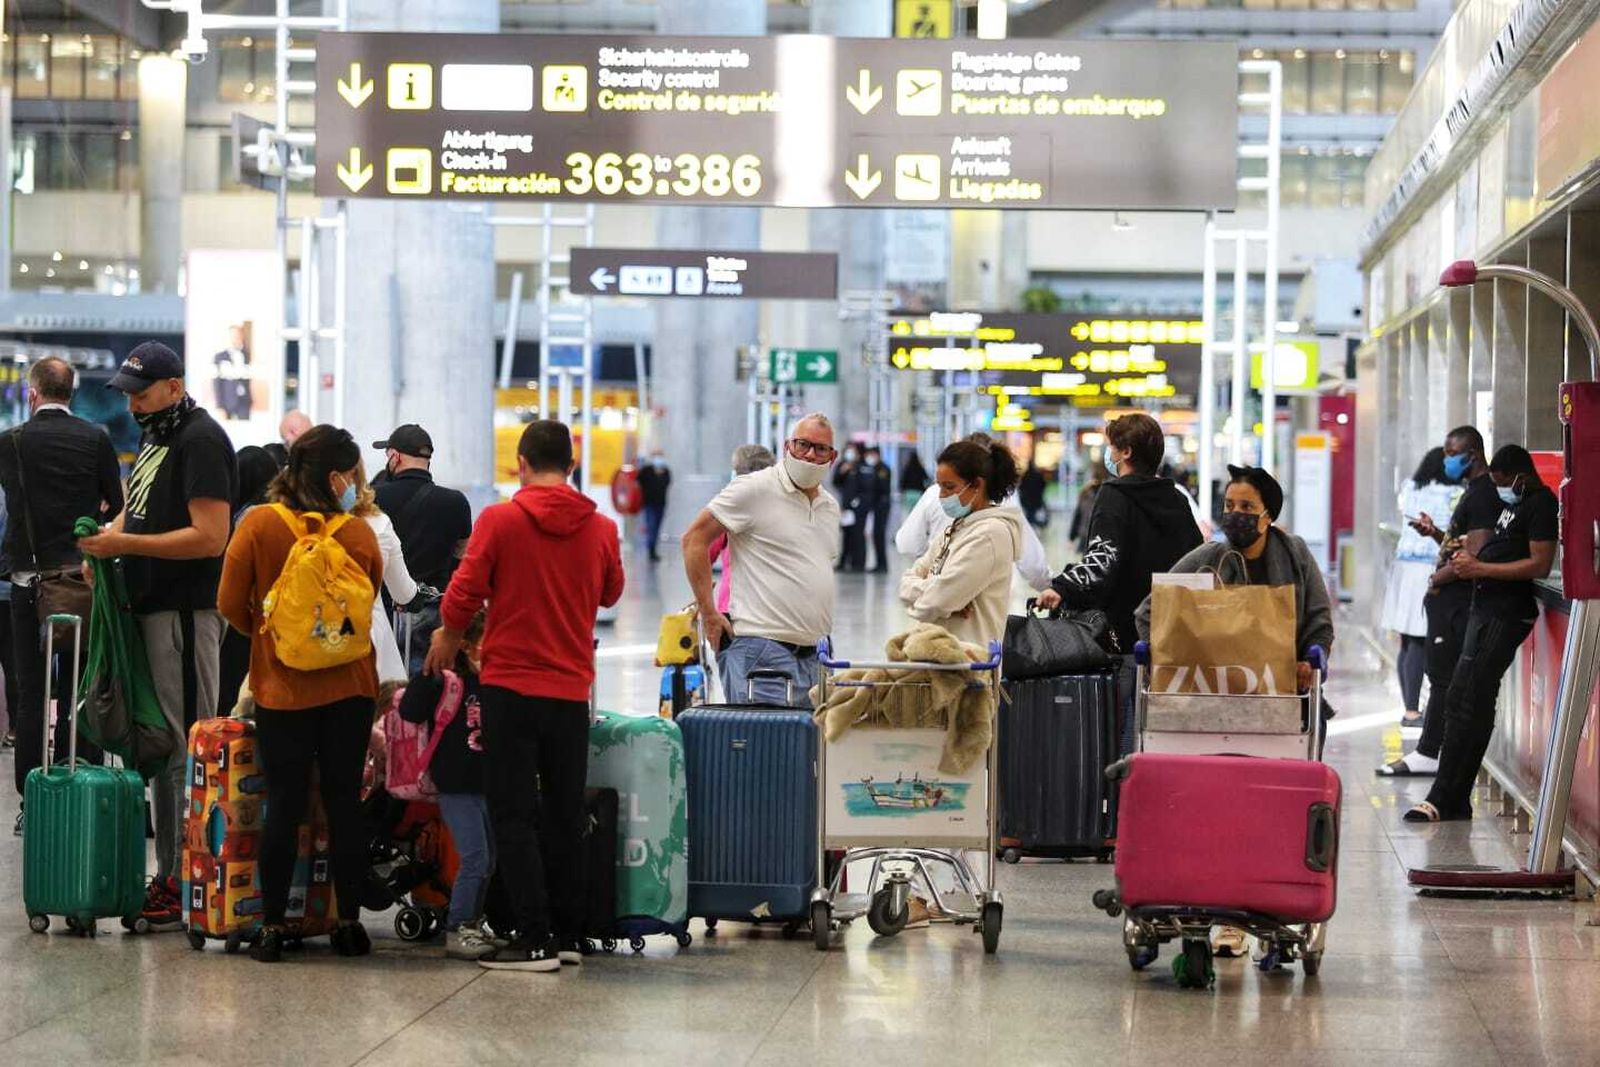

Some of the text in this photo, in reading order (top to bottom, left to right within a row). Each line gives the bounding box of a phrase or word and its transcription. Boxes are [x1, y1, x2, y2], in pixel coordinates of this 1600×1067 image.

[599, 69, 720, 91] Security control
[951, 72, 1069, 95] Boarding gates
[598, 89, 784, 115] Control de segurid
[951, 93, 1166, 119] Puertas de embarque
[441, 151, 507, 170] Check-in
[951, 157, 1011, 176] Arrivals
[441, 171, 561, 194] Facturación
[564, 152, 653, 195] 363
[654, 154, 672, 173] to
[672, 153, 762, 197] 386
[950, 178, 1042, 203] Llegadas
